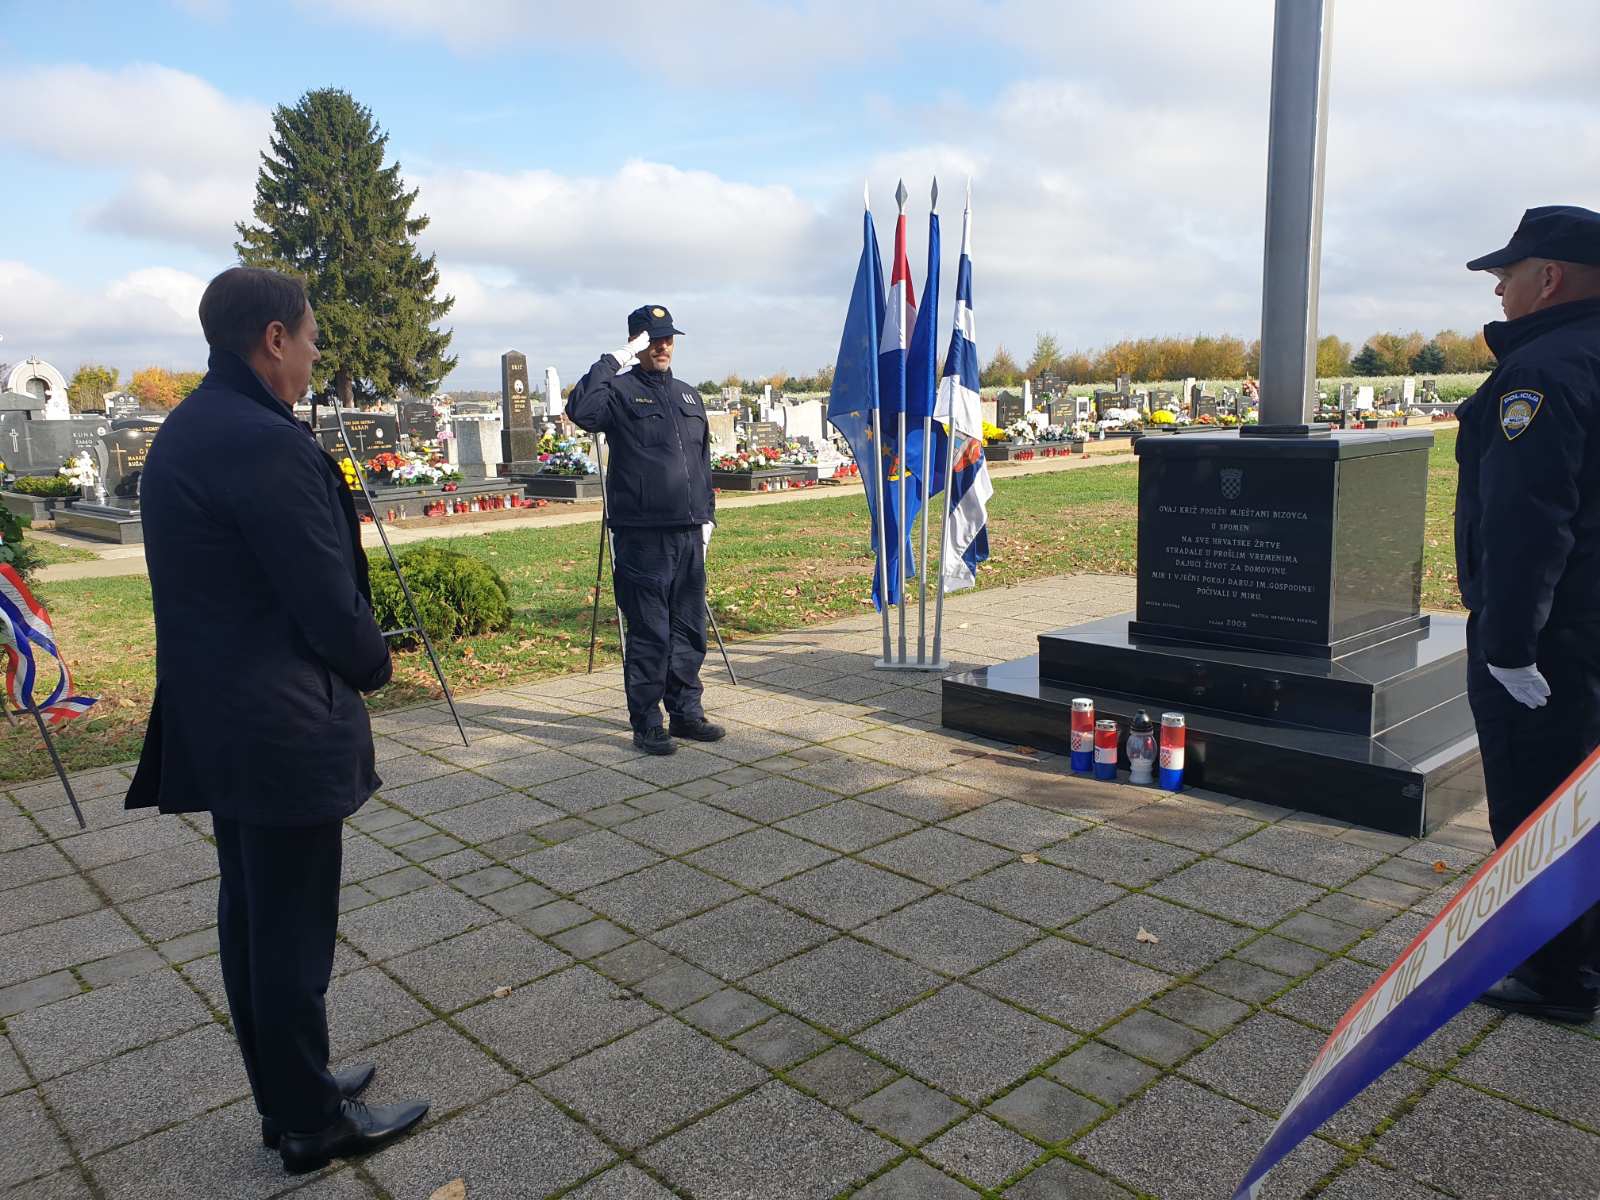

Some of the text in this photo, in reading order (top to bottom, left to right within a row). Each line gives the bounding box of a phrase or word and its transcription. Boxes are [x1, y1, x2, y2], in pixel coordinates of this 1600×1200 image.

[1503, 392, 1539, 403] POLICIJA
[1159, 505, 1177, 513] OVAJ
[1273, 511, 1308, 520] BIZOVCA
[1211, 522, 1249, 531] U SPOMEN
[1181, 535, 1281, 549] NA SVE HRVATSKE ŽRTVE
[1166, 546, 1203, 556] STRADALE
[1249, 552, 1298, 564] VREMENIMA
[1204, 560, 1227, 570] ŽIVOT
[1230, 563, 1240, 571] ZA
[1202, 575, 1225, 584] POKOJ
[1387, 941, 1428, 1011] NA
[1443, 779, 1593, 959] POGINULE
